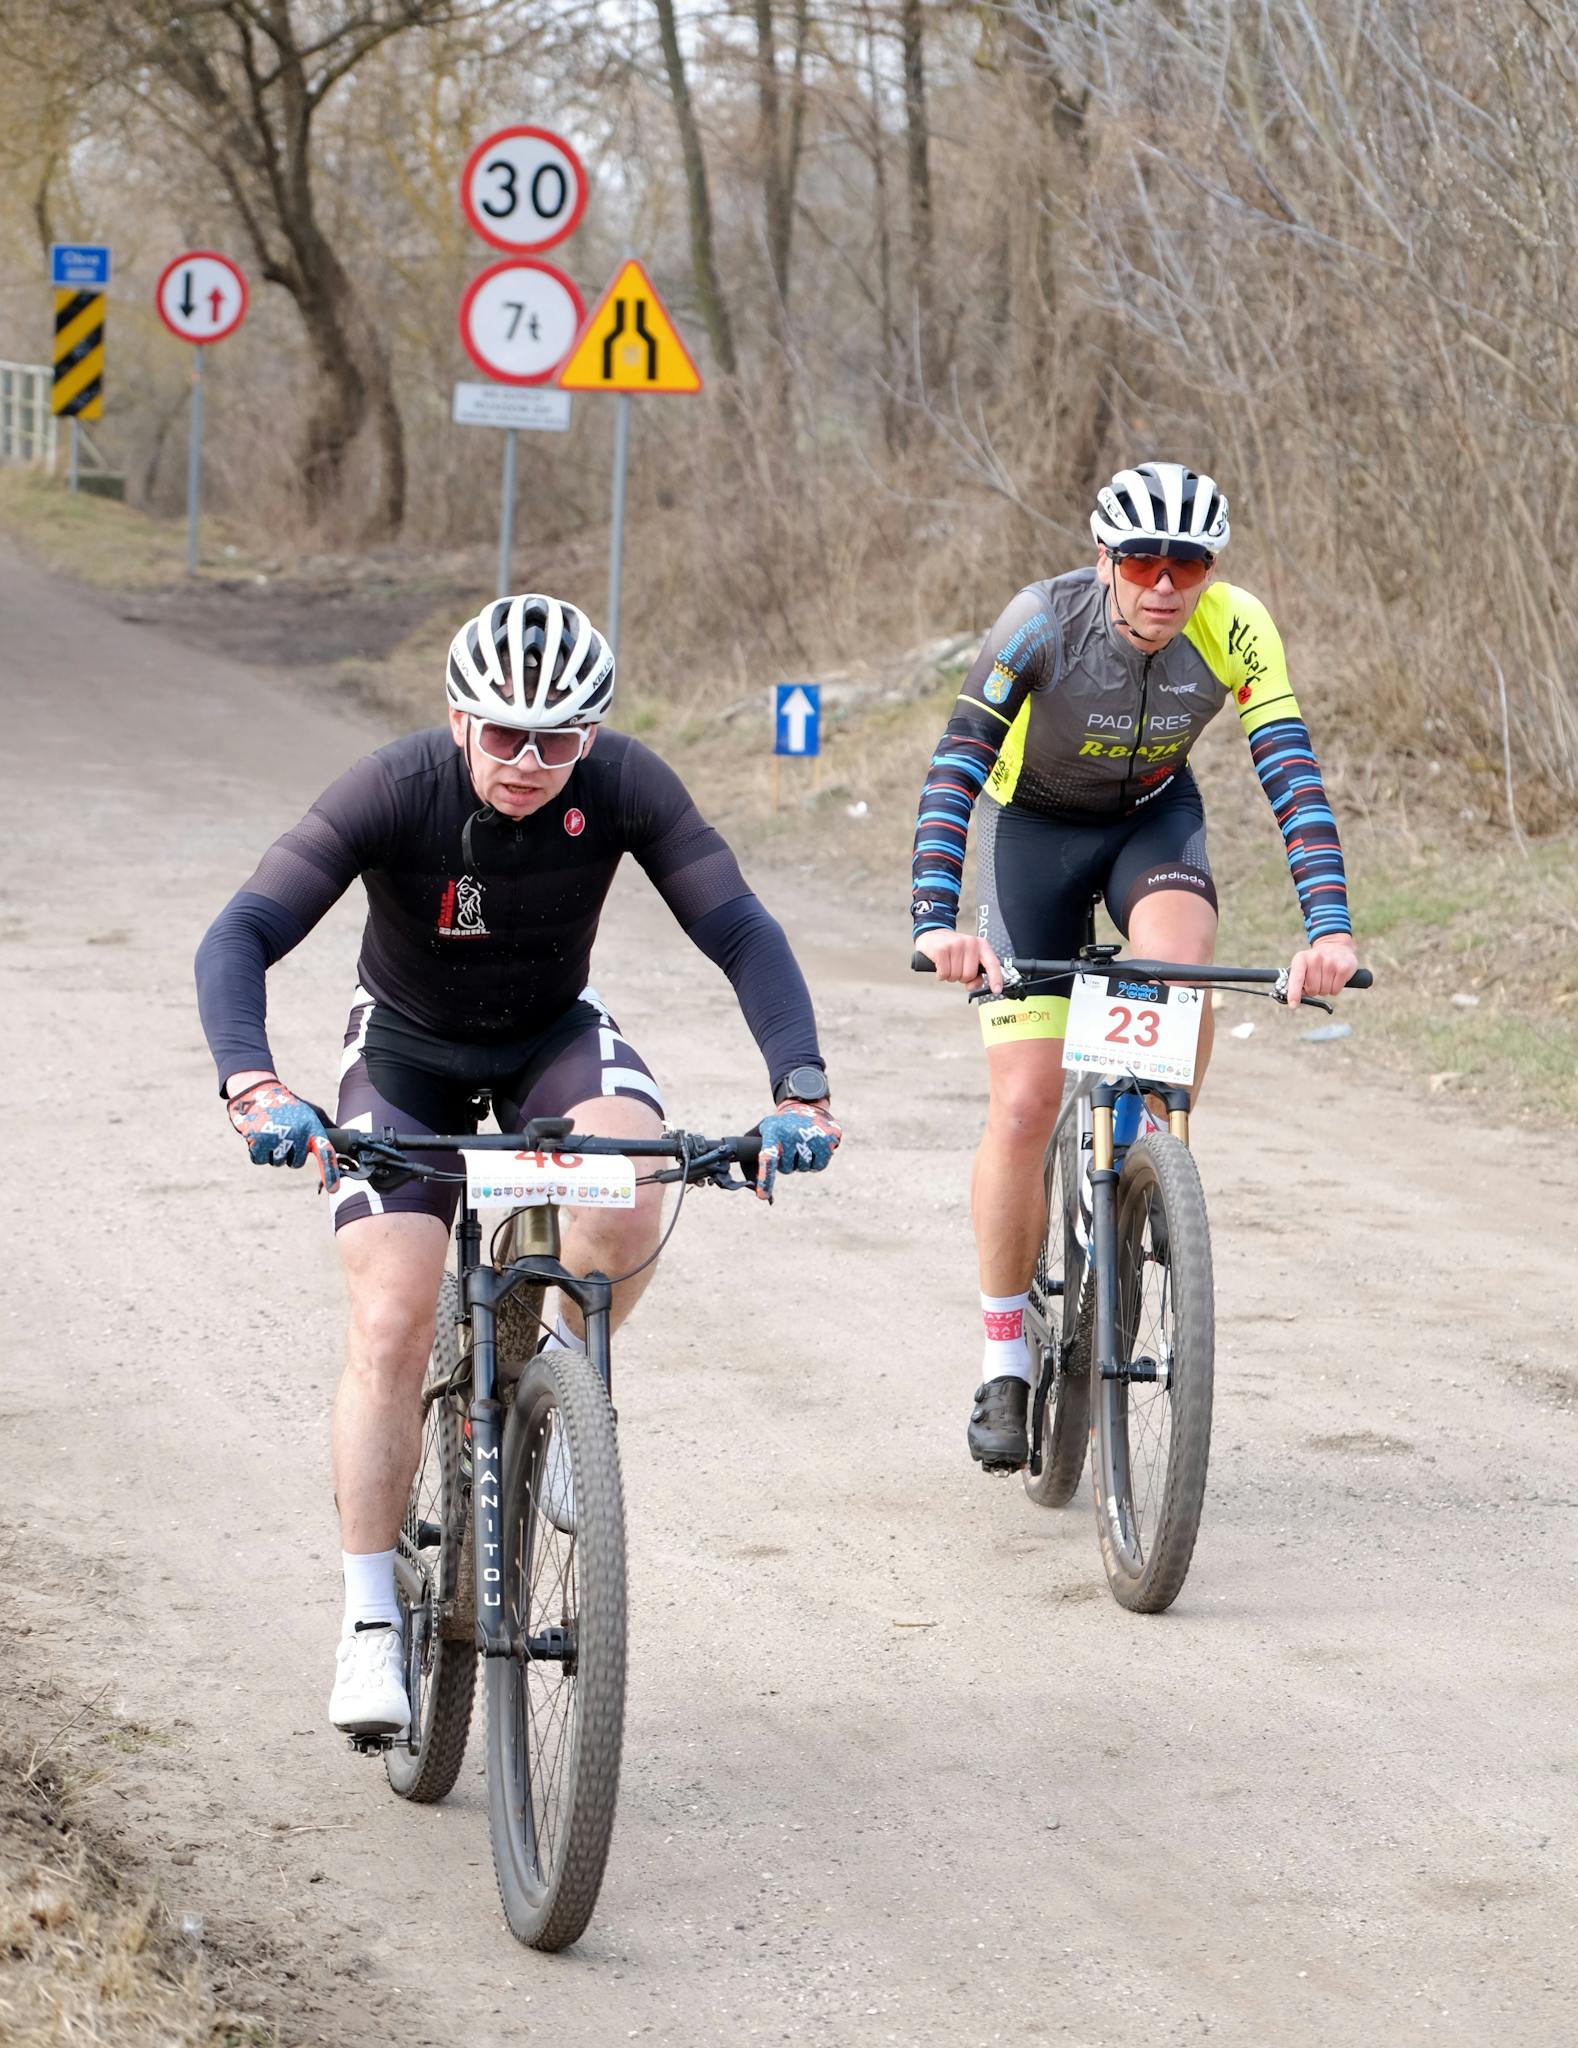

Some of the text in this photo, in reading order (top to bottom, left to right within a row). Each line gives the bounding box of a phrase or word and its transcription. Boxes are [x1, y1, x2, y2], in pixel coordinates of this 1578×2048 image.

[482, 161, 567, 219] 30
[503, 302, 540, 341] 7t
[1104, 1006, 1161, 1047] 23
[476, 1446, 501, 1607] MANITOU
